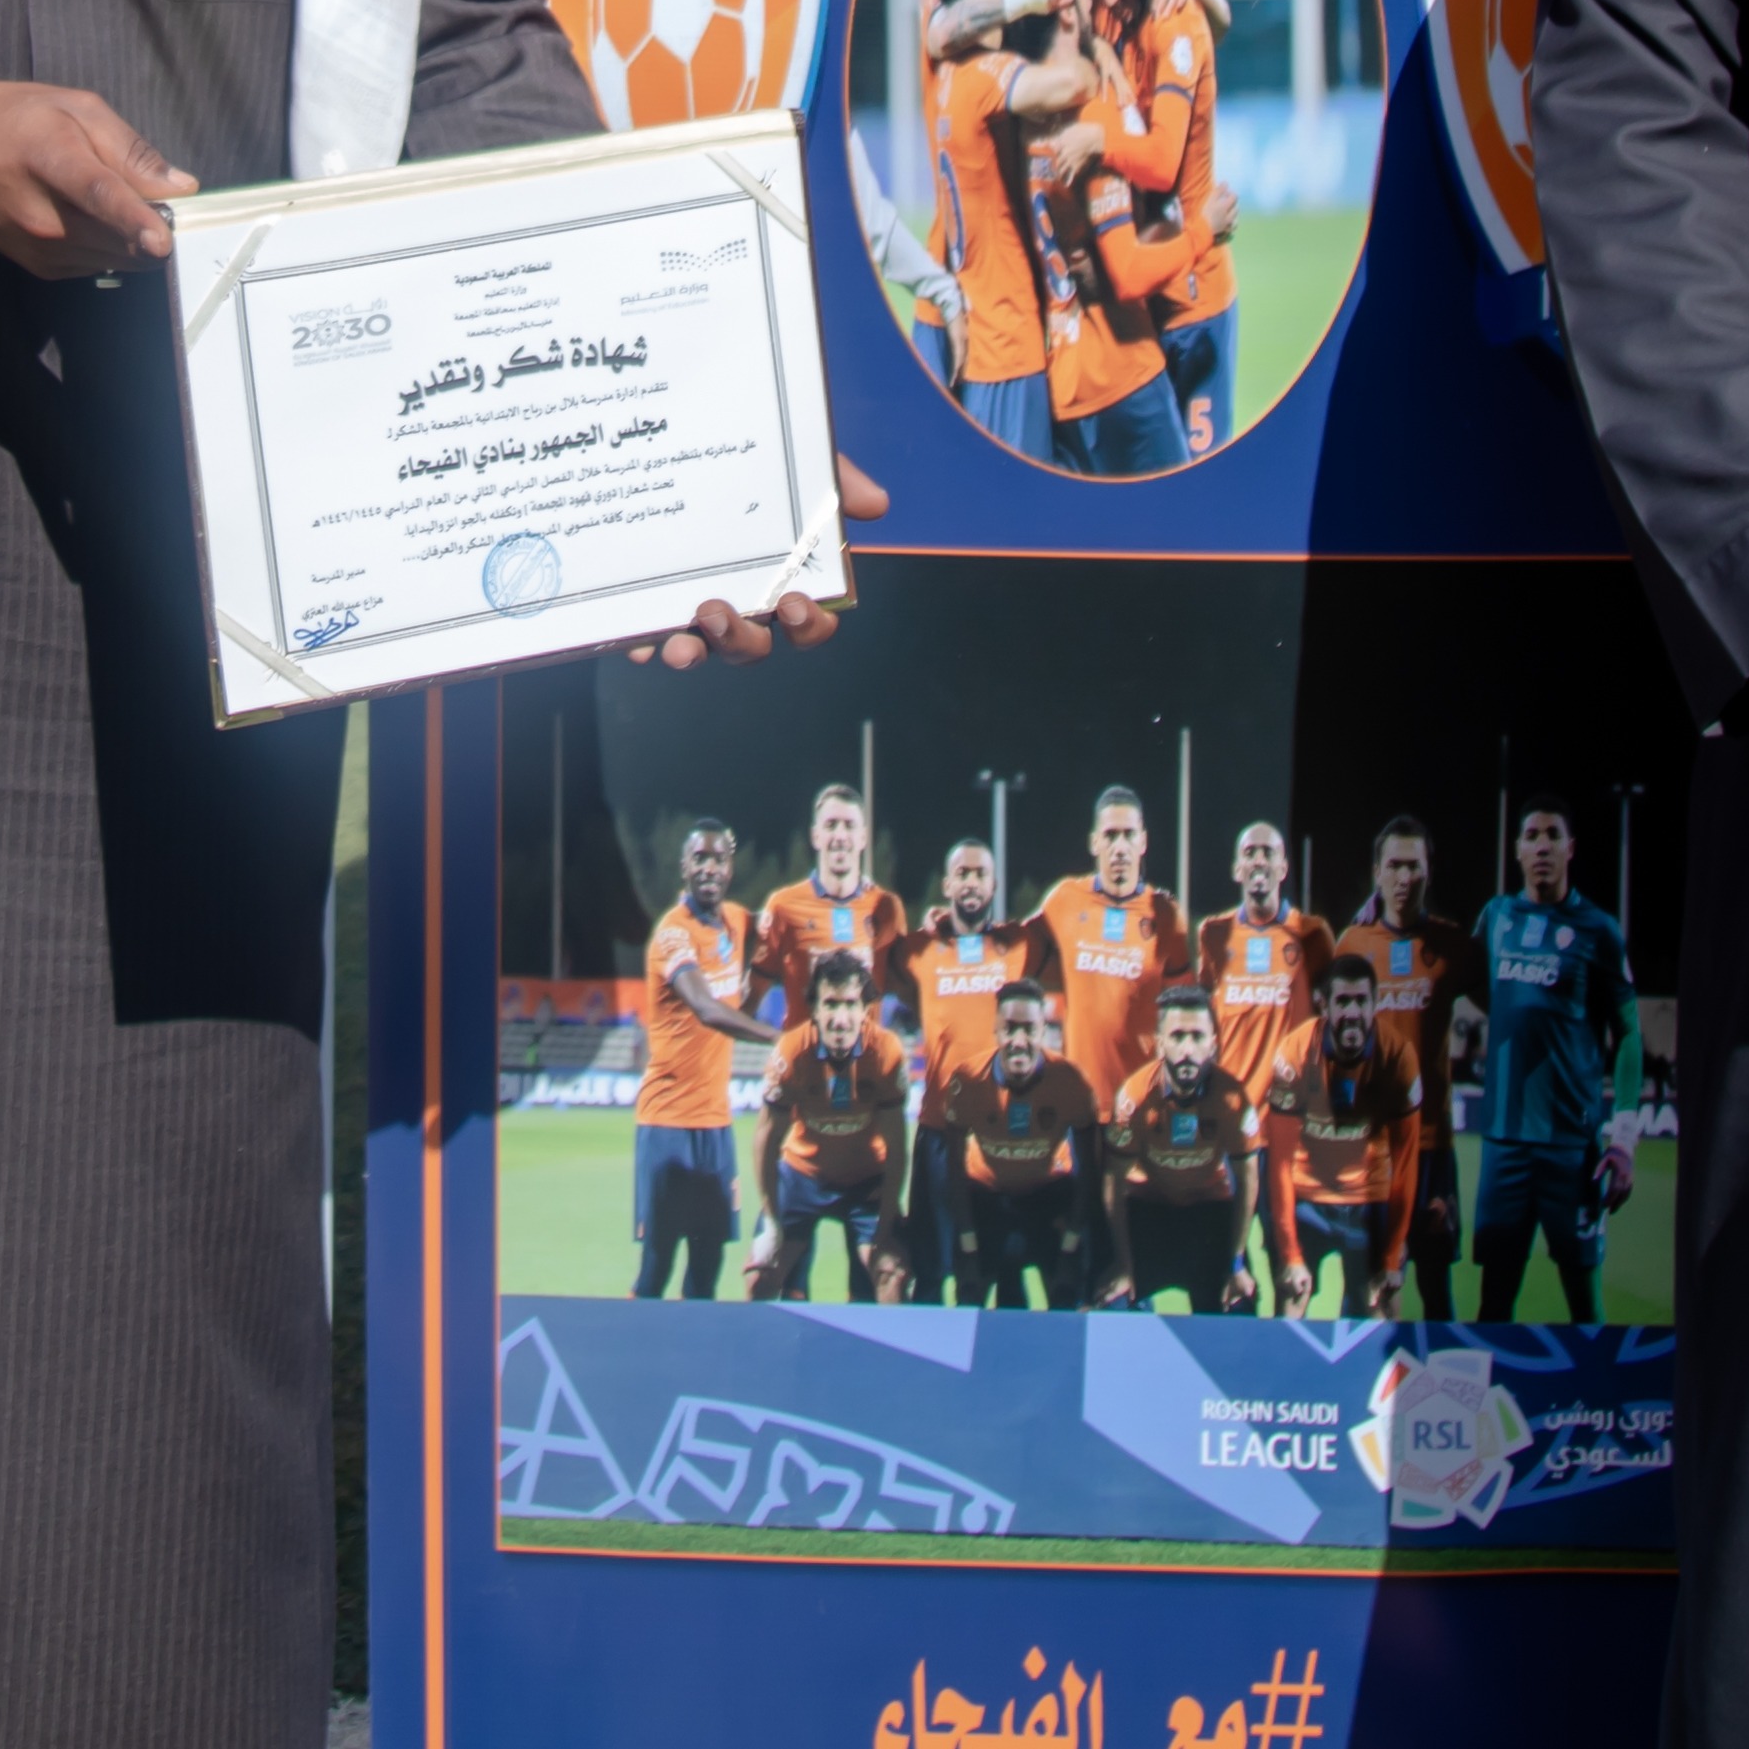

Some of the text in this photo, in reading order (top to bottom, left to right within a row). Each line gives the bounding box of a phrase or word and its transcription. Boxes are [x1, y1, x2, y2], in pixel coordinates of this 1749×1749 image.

[491, 339, 564, 388] شكر
[569, 335, 649, 373] شهادة
[396, 356, 485, 416] وتقدير
[523, 403, 543, 421] رباح
[544, 403, 557, 415] بن
[559, 396, 579, 411] بلال
[580, 394, 614, 407] مدرسة
[1188, 397, 1214, 452] 5
[397, 414, 668, 483] مجلس الجمهور بنادي الفيحاء
[1075, 951, 1144, 980] BASIC
[1497, 959, 1560, 987] BASIC
[937, 974, 1006, 997] BASIC
[1224, 985, 1292, 1007] BASIC
[1375, 990, 1430, 1012] ASIC
[1201, 1398, 1340, 1426] ROSHN SAUDI
[1618, 1407, 1673, 1433] وري
[1412, 1419, 1473, 1451] RSL
[1199, 1430, 1339, 1471] LEAGUE
[1545, 1440, 1673, 1480] لسعودي
